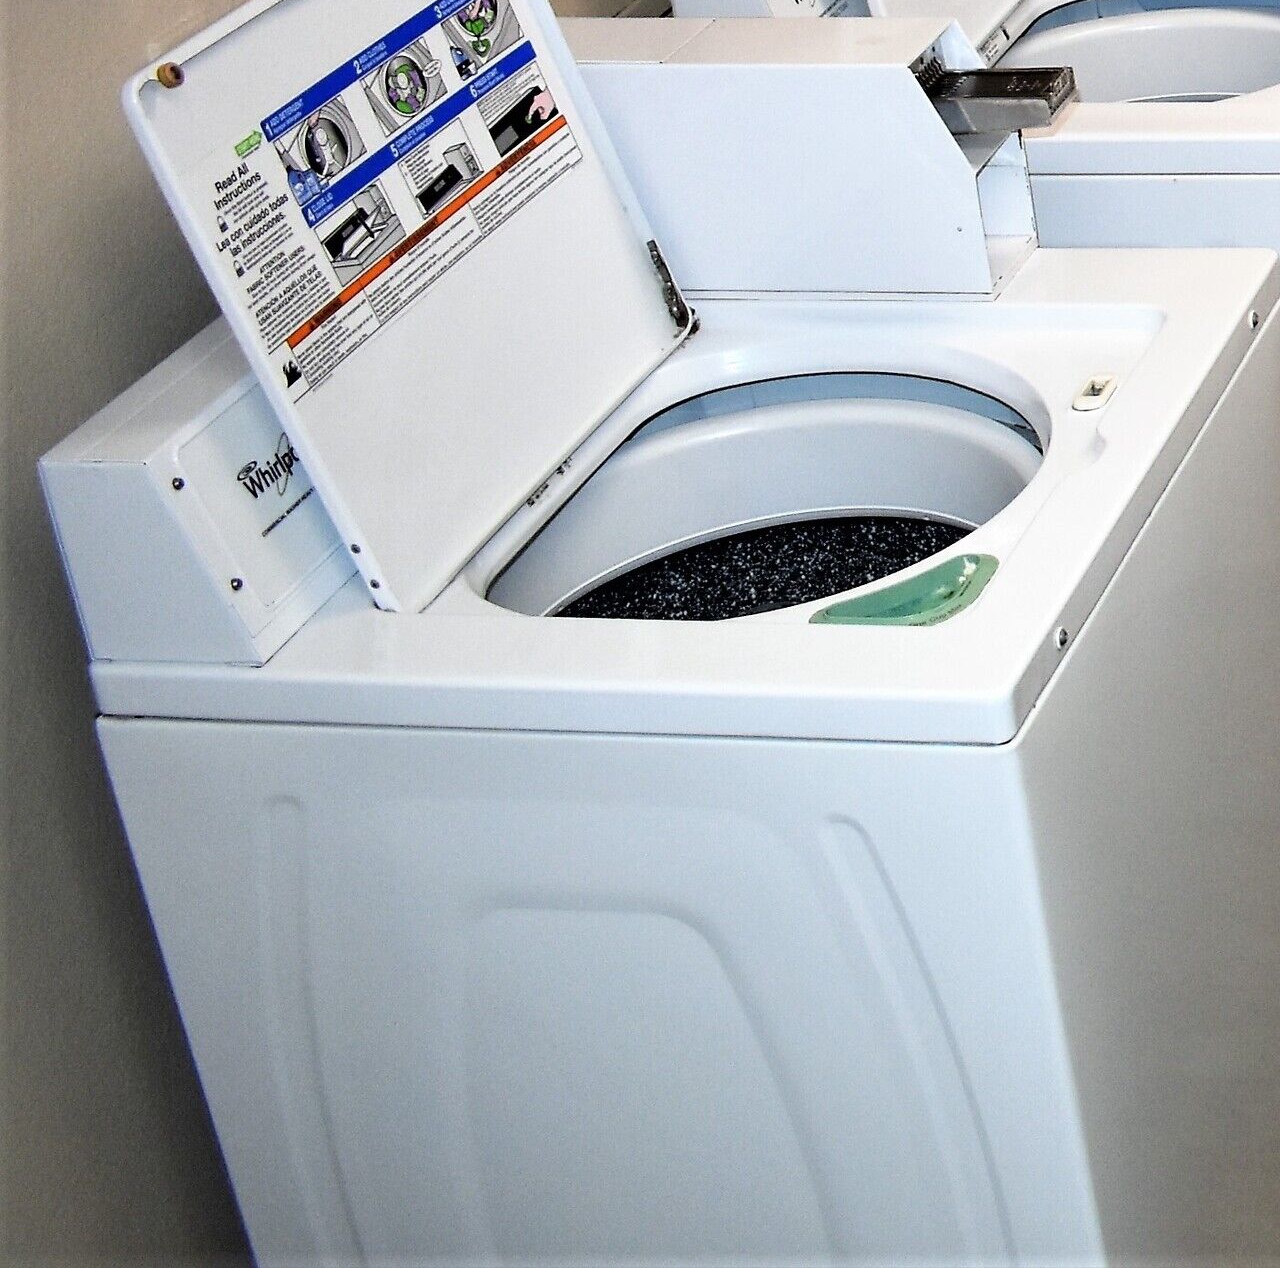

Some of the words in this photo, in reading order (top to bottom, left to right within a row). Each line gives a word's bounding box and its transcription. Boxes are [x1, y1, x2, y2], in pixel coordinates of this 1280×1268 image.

[433, 4, 442, 19] 3
[352, 58, 362, 75] 2
[468, 83, 478, 98] 6
[264, 121, 273, 137] 1
[389, 142, 399, 158] 5
[214, 170, 237, 194] Read
[236, 161, 249, 177] All
[213, 168, 261, 211] Instructions
[215, 234, 230, 253] Lea
[229, 226, 243, 242] con
[242, 204, 269, 232] cuidado
[268, 190, 288, 212] todas
[305, 206, 315, 223] 4
[229, 241, 241, 257] las
[240, 207, 286, 249] instrucciones.
[258, 249, 285, 274] ATTENTION
[263, 257, 289, 281] SOFTENER
